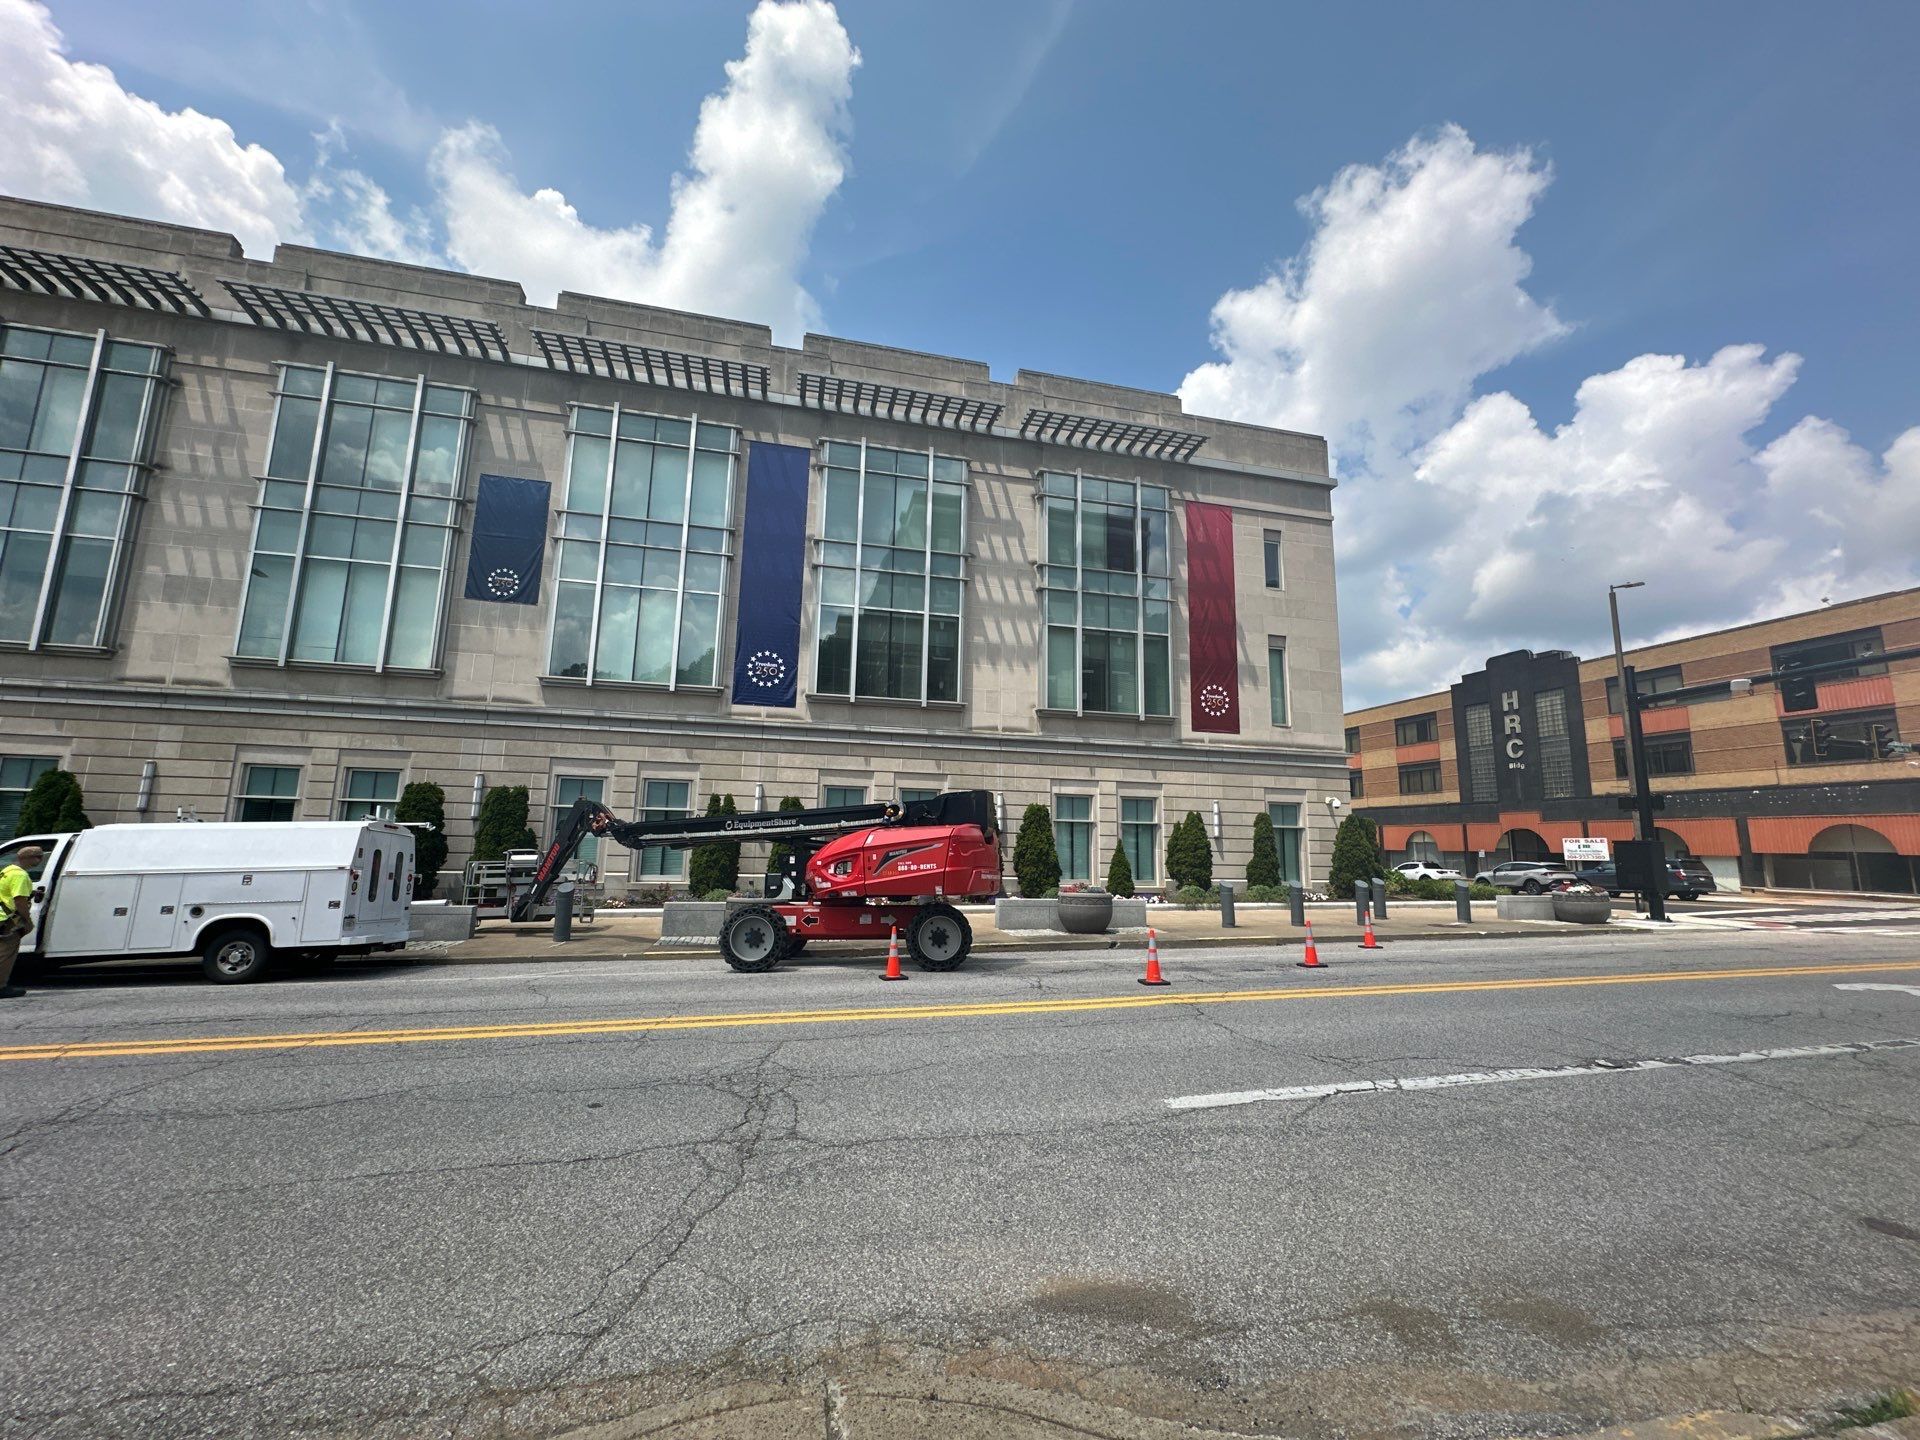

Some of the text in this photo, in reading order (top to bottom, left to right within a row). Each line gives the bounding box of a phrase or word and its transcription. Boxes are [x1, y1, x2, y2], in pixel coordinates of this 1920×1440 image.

[494, 580, 513, 588] 250
[755, 666, 778, 678] 250
[1207, 698, 1224, 708] 250
[1508, 762, 1525, 770] Bldg
[733, 818, 797, 829] EquipmentShare
[537, 842, 560, 881] MANITOU
